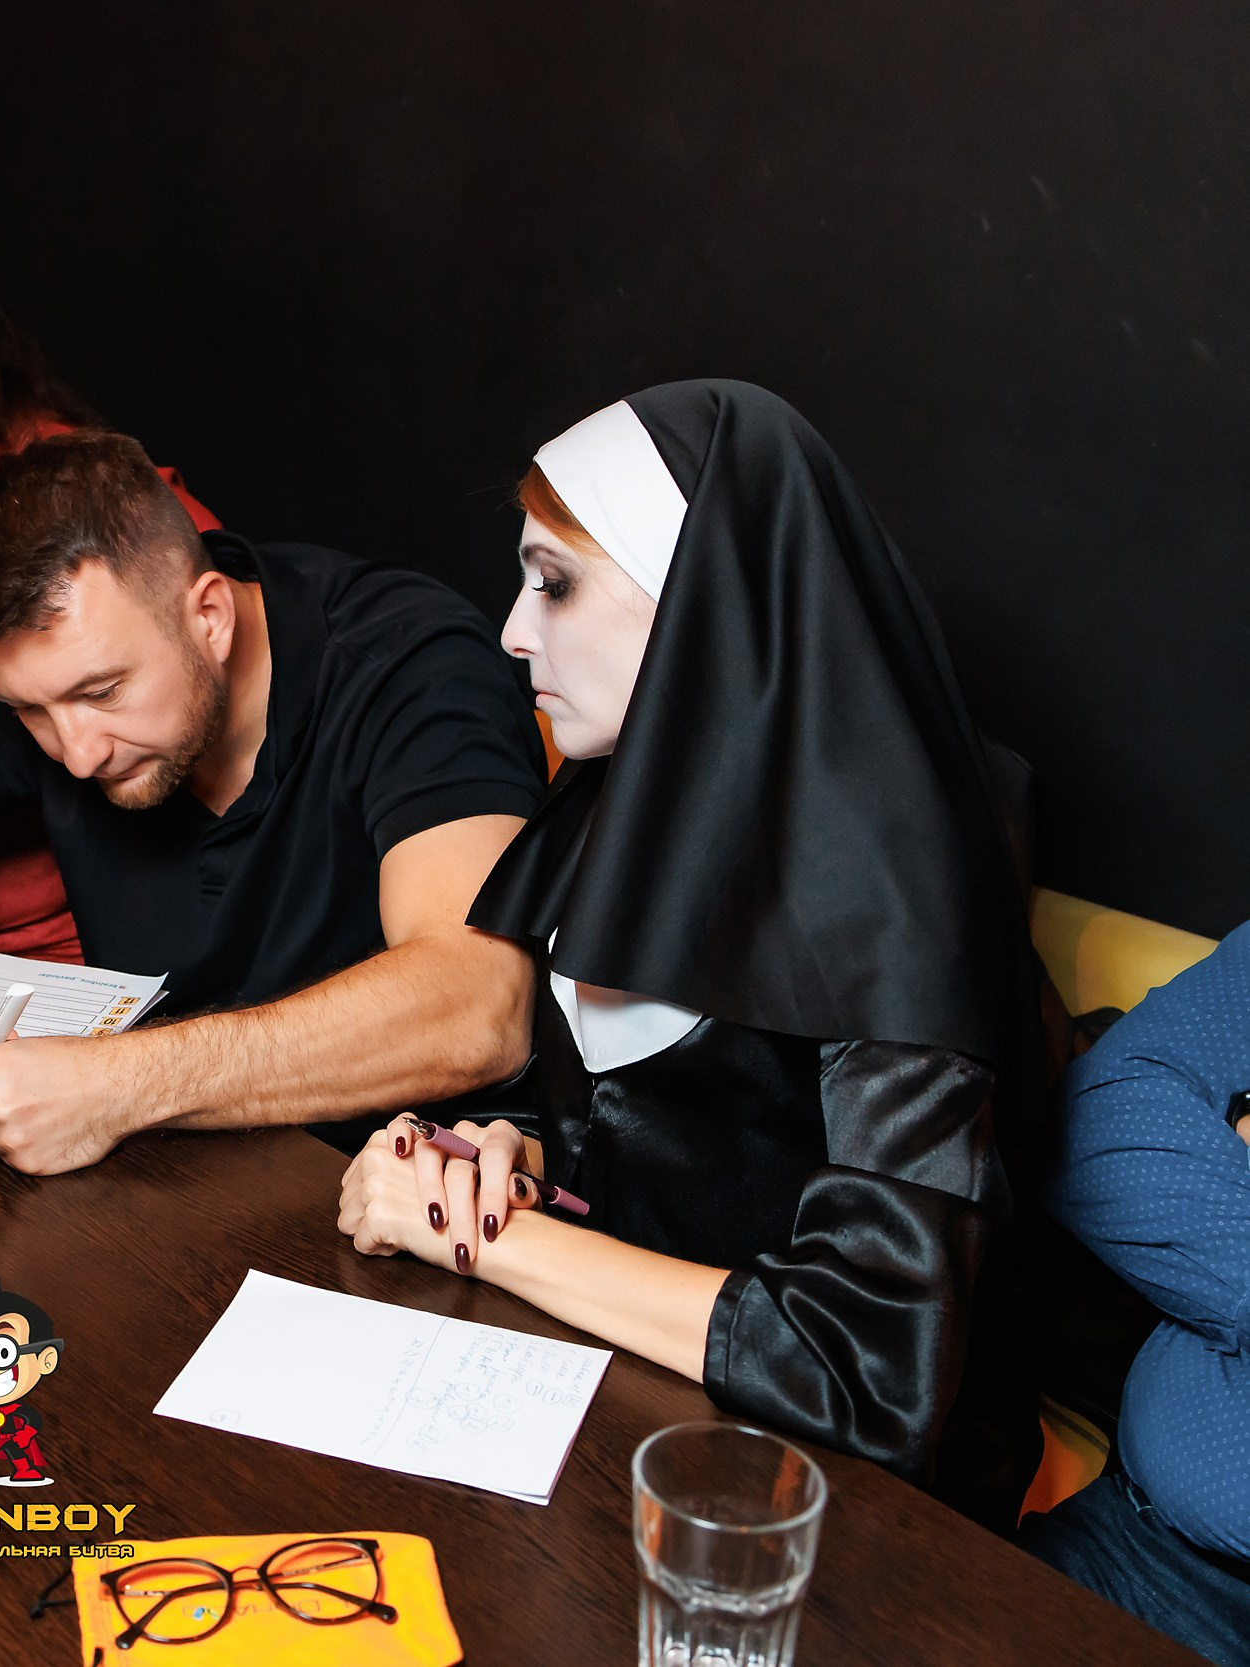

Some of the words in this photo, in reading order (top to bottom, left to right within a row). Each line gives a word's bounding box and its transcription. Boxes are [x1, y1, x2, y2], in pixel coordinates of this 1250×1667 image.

[123, 997, 135, 1005] 12
[115, 1007, 126, 1015] 11
[103, 1017, 118, 1026] 10
